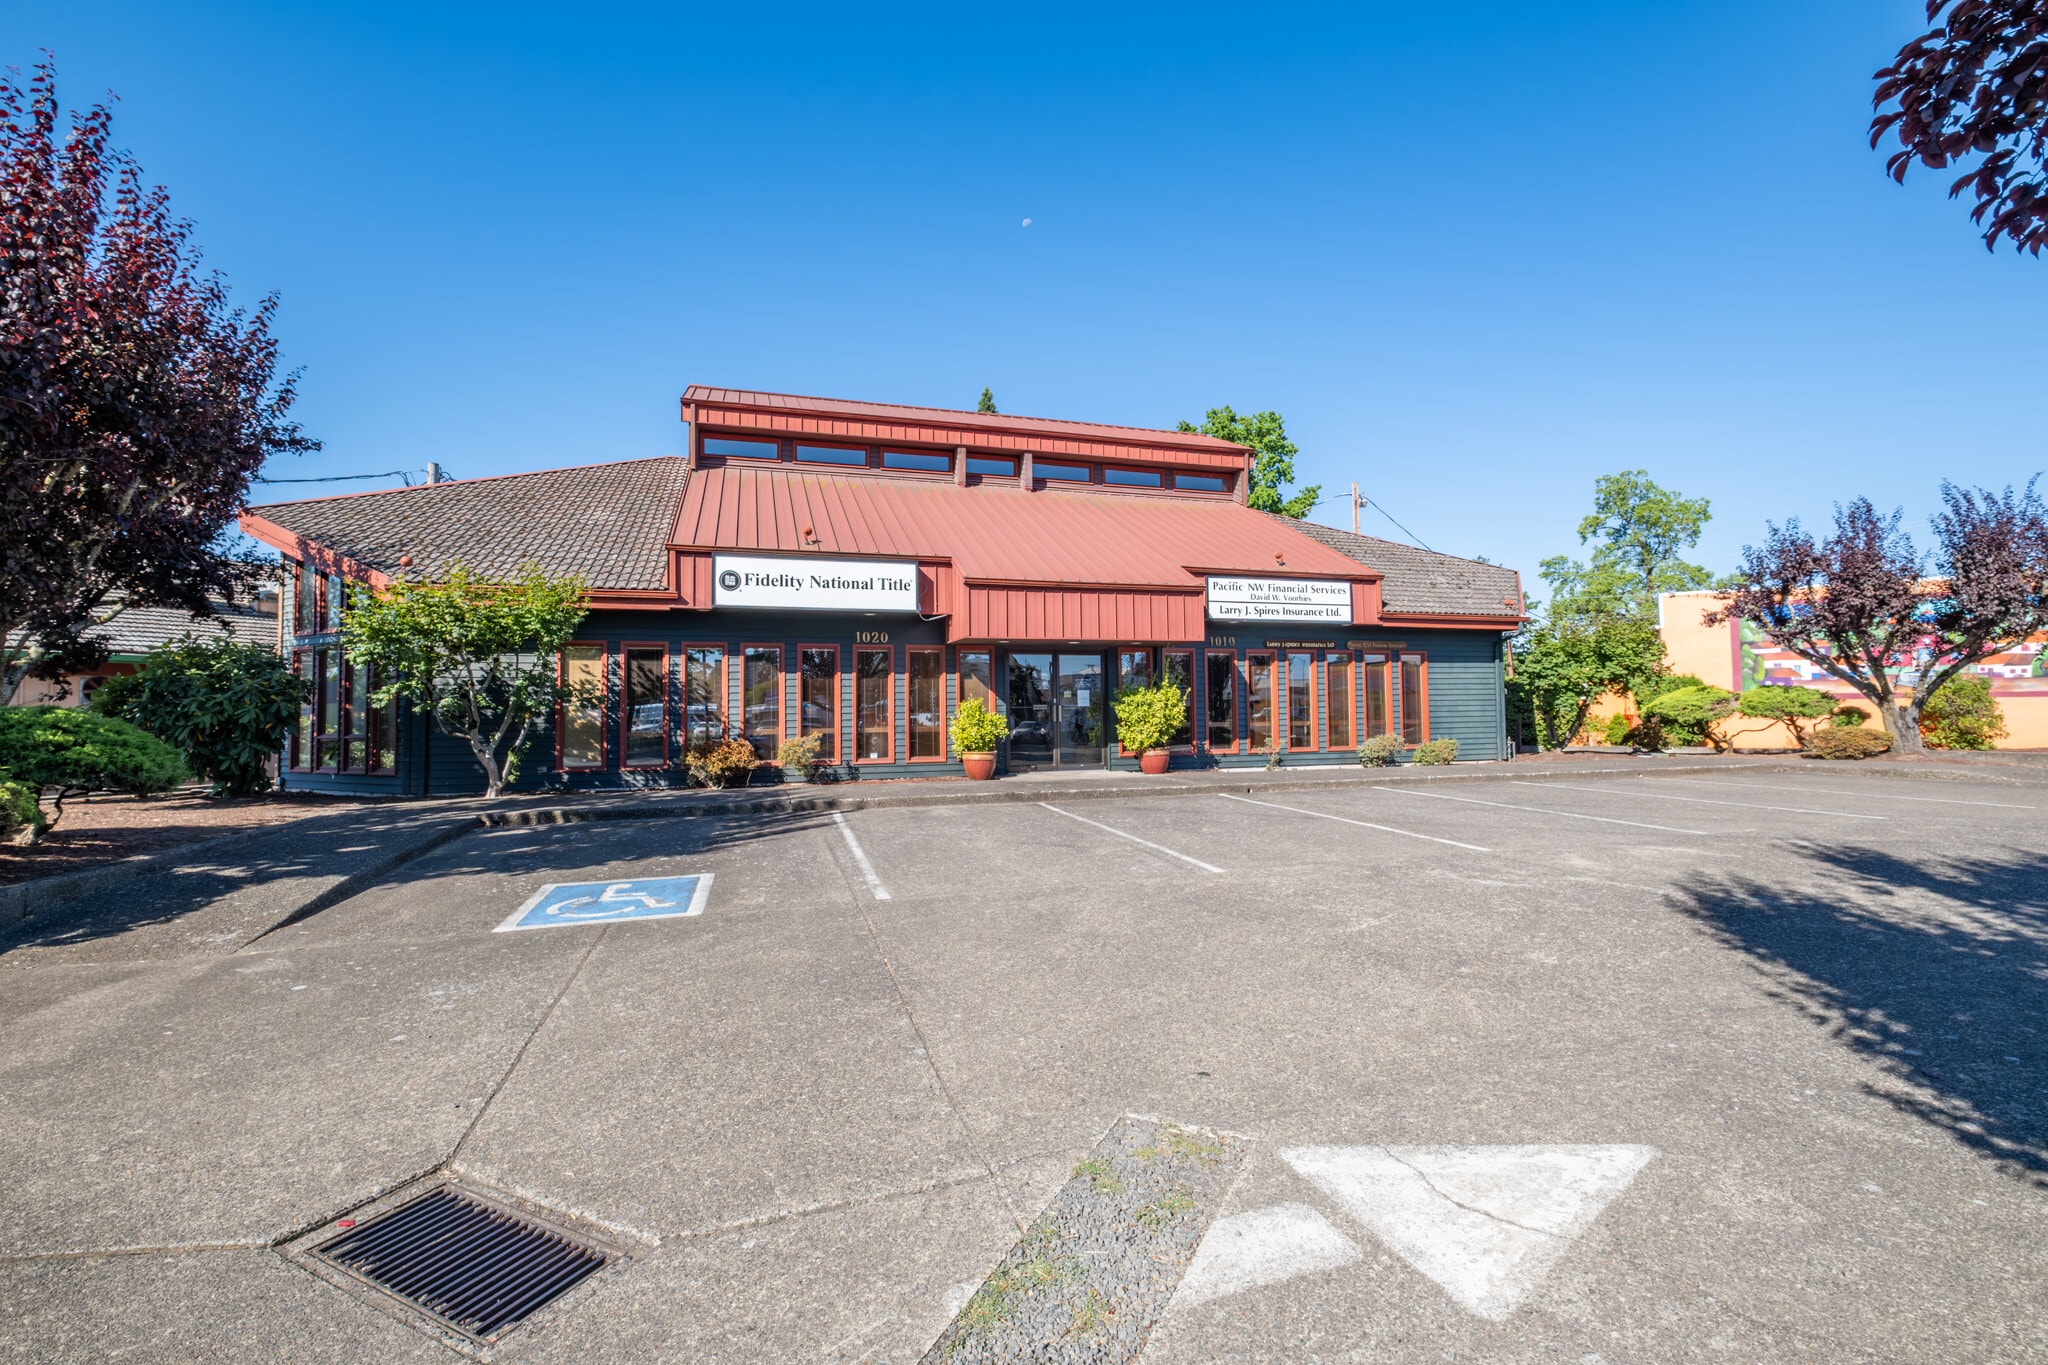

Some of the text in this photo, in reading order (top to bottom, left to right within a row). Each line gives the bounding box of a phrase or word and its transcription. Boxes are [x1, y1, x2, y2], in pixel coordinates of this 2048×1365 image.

[744, 572, 911, 591] Fidelity National Title
[1213, 581, 1347, 595] Pacific NW Financial Services
[1250, 593, 1270, 601] David
[1283, 594, 1312, 602] Voorhies
[1219, 605, 1341, 618] Larry J. Spires Insurance Ltd.
[856, 631, 889, 643] 1020
[1210, 636, 1236, 647] 1010
